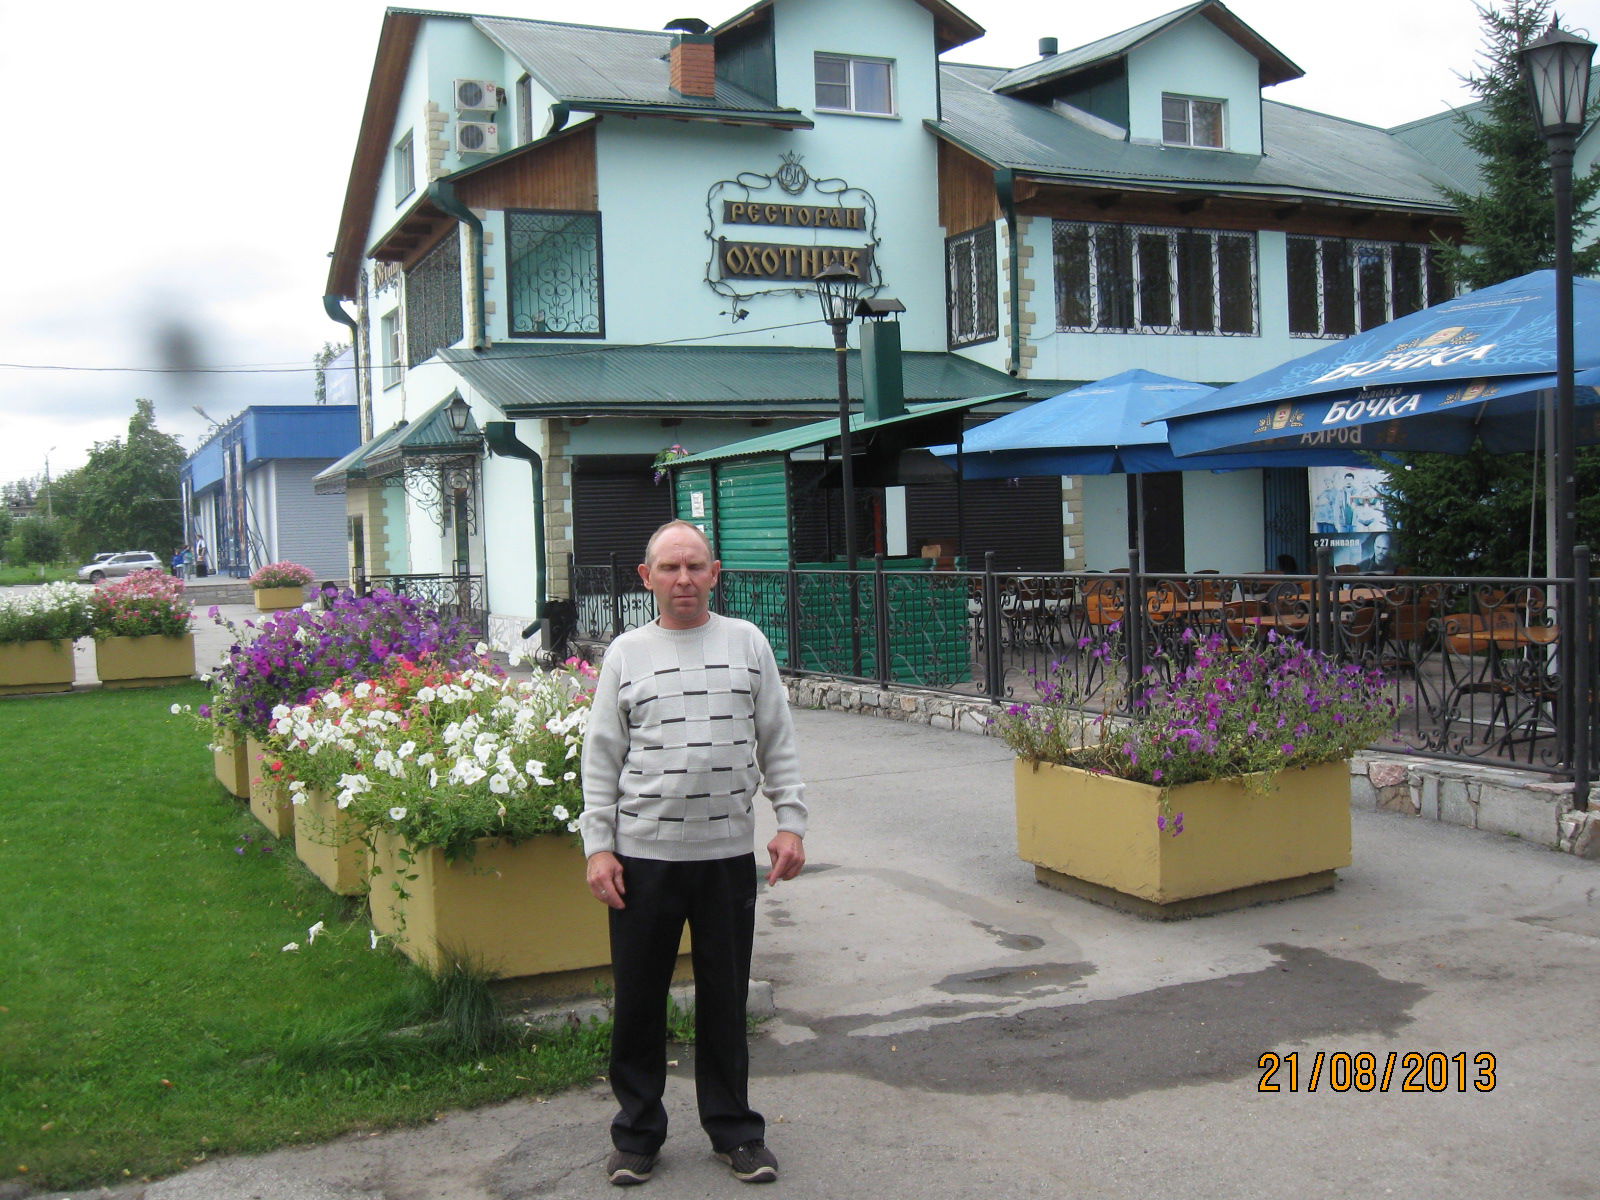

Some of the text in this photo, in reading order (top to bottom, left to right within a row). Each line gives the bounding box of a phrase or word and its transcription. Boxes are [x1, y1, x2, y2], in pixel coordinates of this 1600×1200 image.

[731, 202, 861, 229] РЕСТОРАН
[1311, 343, 1497, 384] БОЧКА
[1322, 393, 1422, 425] БОЧКА
[1320, 538, 1329, 547] 27
[1330, 539, 1360, 547] января
